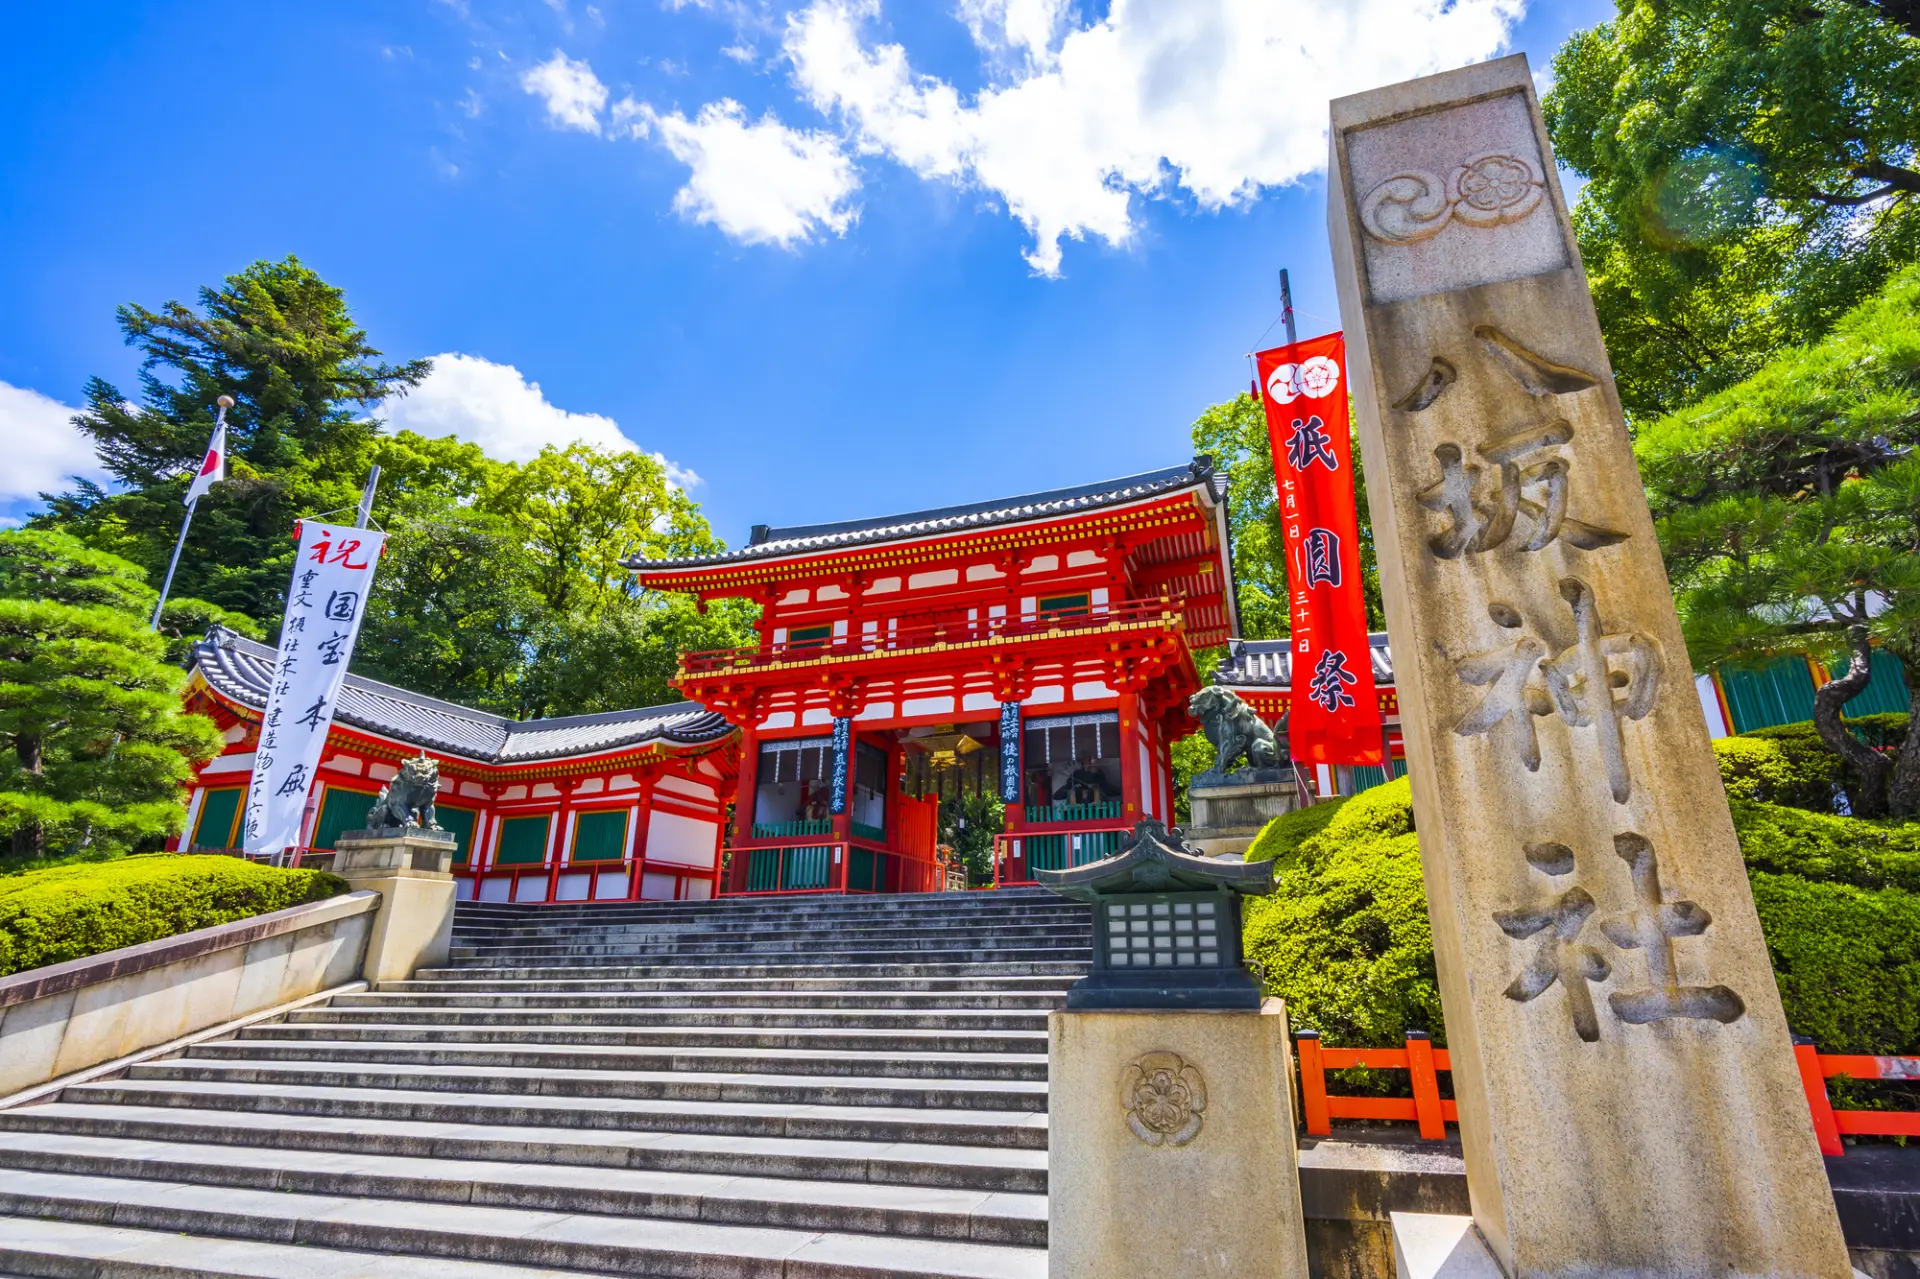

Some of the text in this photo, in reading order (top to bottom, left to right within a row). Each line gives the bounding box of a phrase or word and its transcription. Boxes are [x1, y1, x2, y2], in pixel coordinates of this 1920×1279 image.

[309, 530, 367, 570] 祝
[1284, 414, 1358, 713] 祇園祭
[1391, 323, 1747, 1043] 八坂神社
